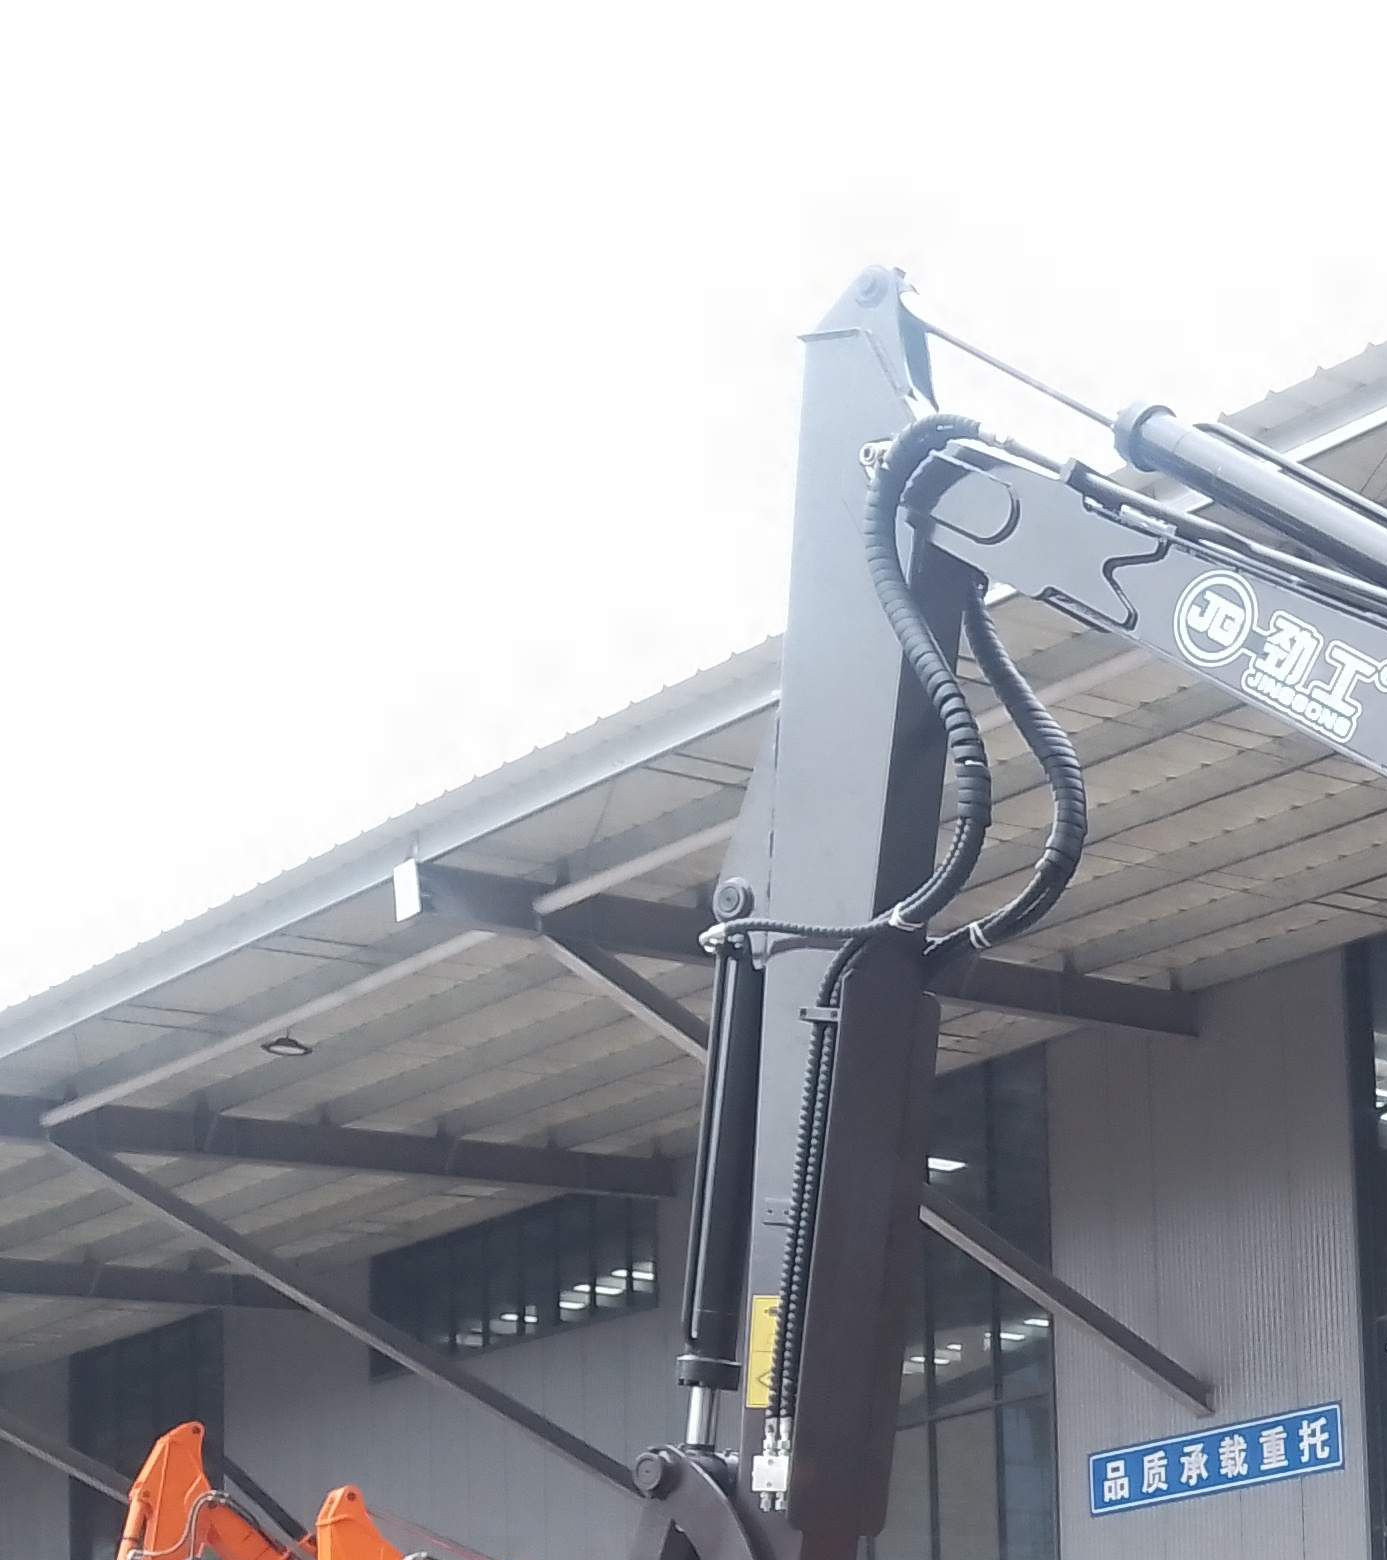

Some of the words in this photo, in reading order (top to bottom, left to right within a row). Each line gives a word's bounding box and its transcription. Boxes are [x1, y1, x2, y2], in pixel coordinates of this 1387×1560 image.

[1102, 1415, 1331, 1503] 品质承载重托
